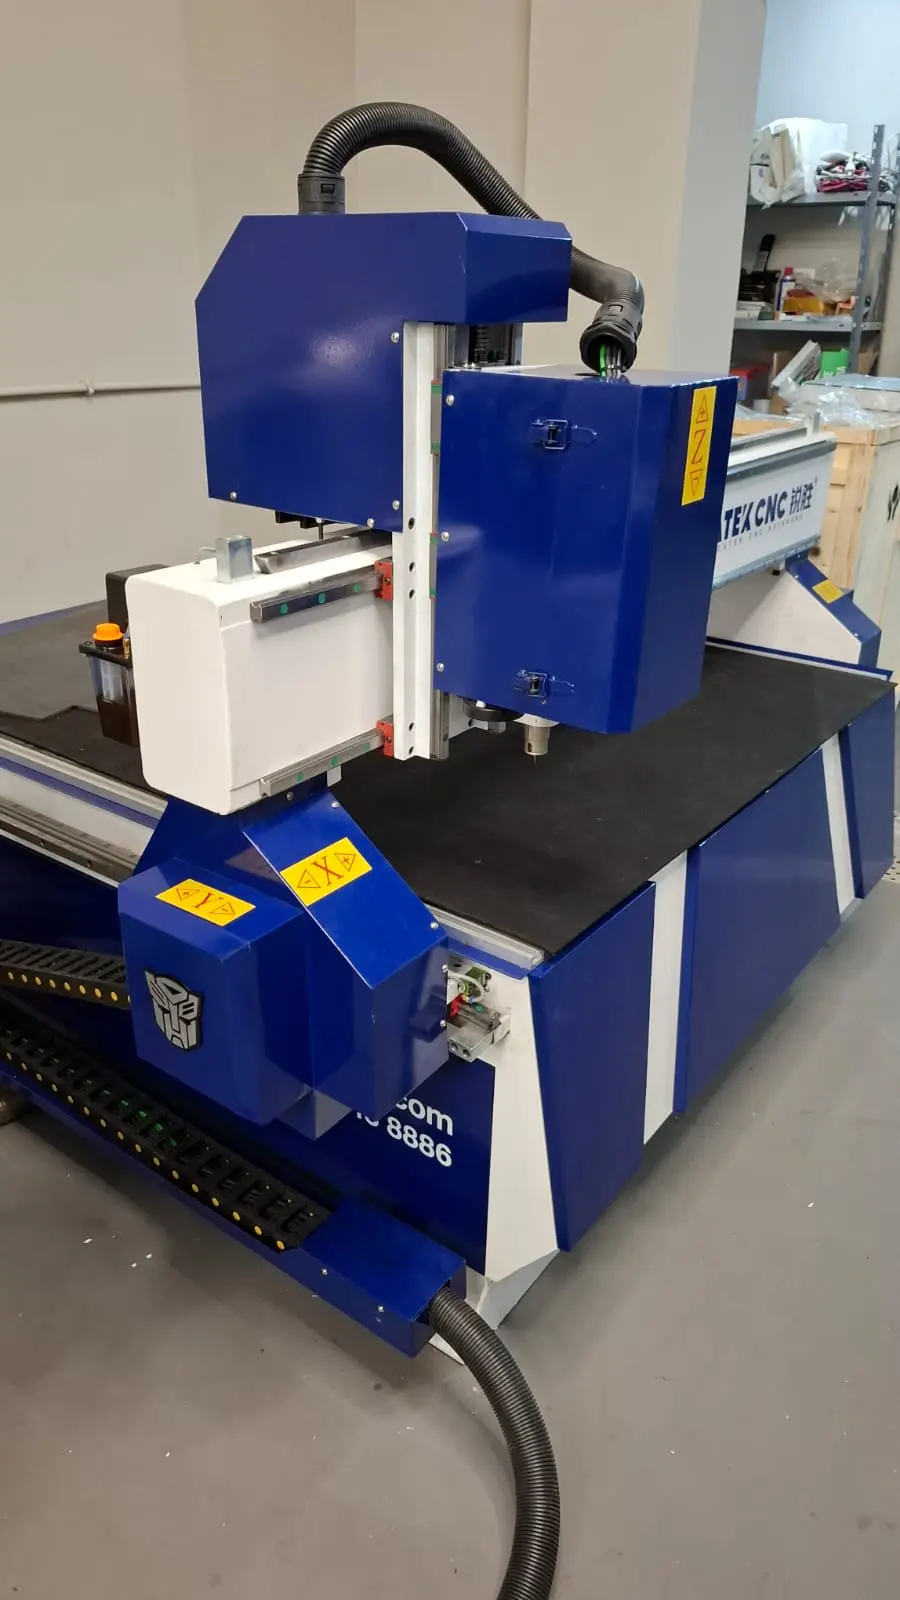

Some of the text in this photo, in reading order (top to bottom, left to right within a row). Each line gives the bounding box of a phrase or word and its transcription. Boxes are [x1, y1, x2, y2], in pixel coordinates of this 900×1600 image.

[691, 429, 706, 464] Z
[718, 491, 788, 542] TEK CNC
[311, 856, 344, 886] X
[194, 892, 224, 909] Y
[386, 1116, 453, 1168] 8886
